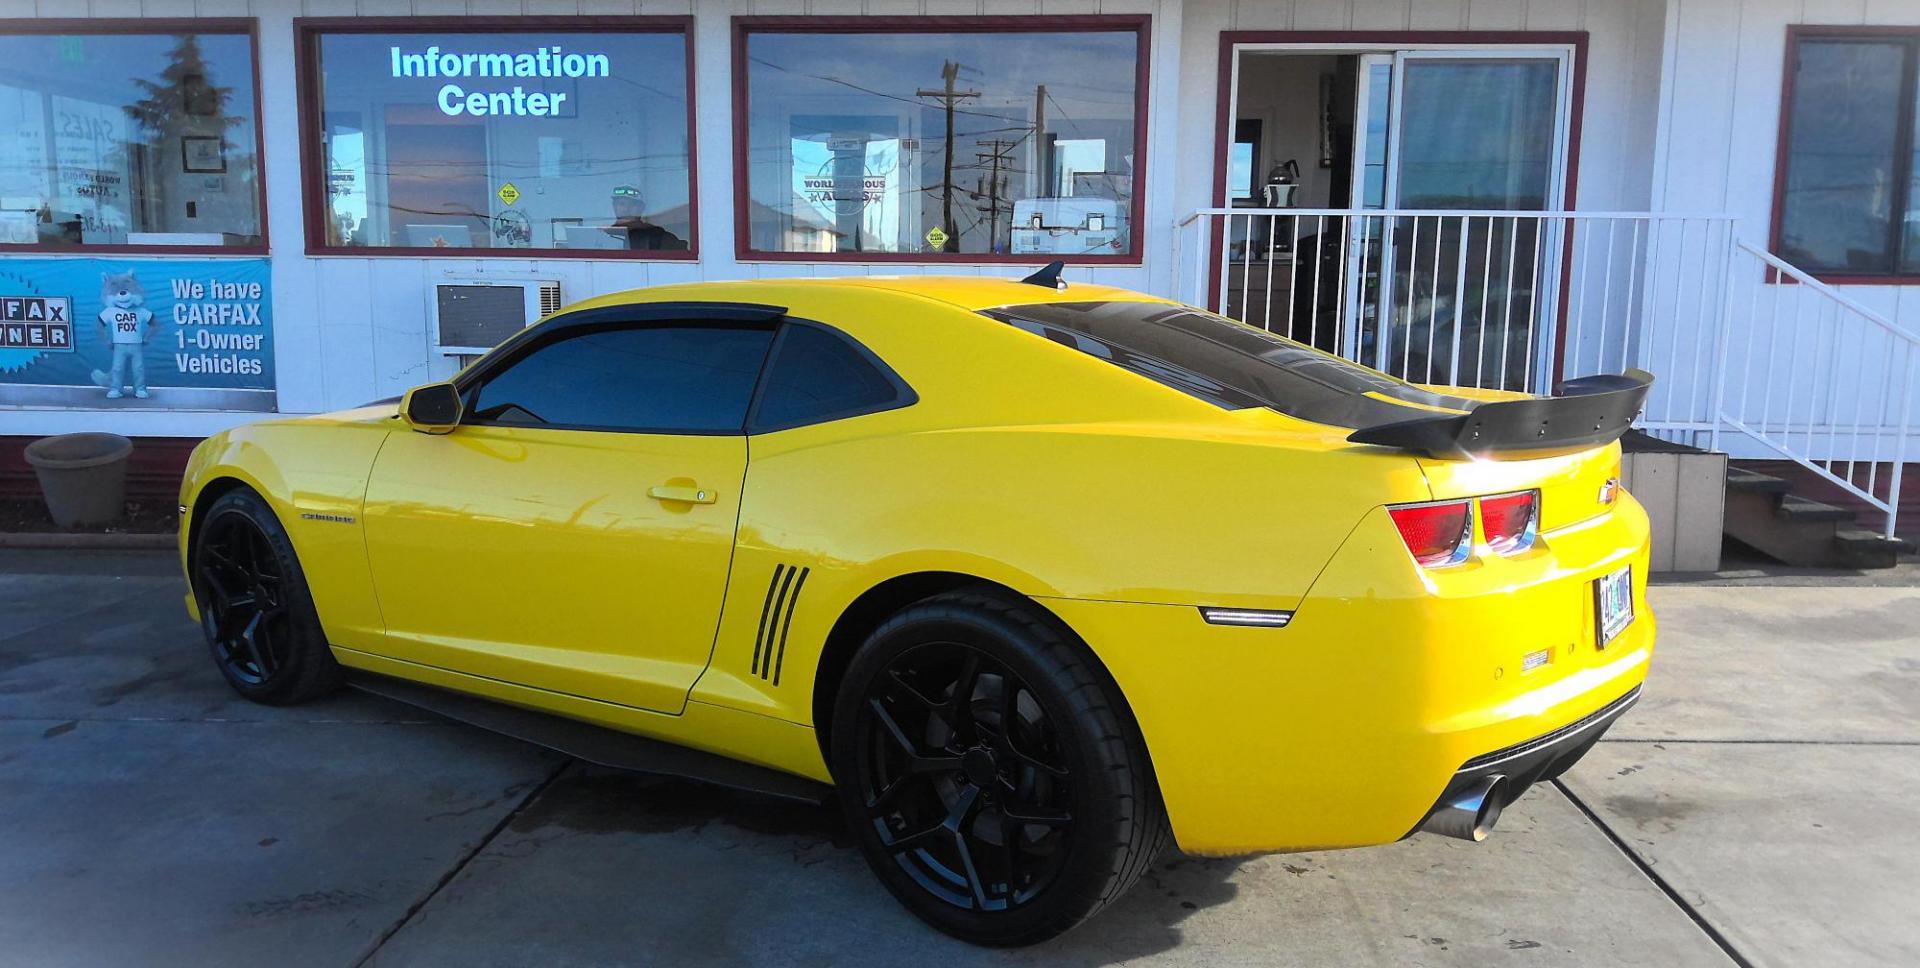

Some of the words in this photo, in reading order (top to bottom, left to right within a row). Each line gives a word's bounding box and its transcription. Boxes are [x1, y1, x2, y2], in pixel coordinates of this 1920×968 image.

[391, 46, 609, 77] Information
[437, 84, 566, 116] Center
[804, 180, 843, 188] WORL
[172, 279, 204, 299] We
[210, 279, 261, 299] have
[115, 313, 137, 322] CAR
[173, 303, 261, 325] CARFAX
[0, 327, 65, 343] NER
[117, 323, 137, 332] FOX
[175, 329, 264, 350] 1-Owner
[176, 353, 262, 375] Vehicles
